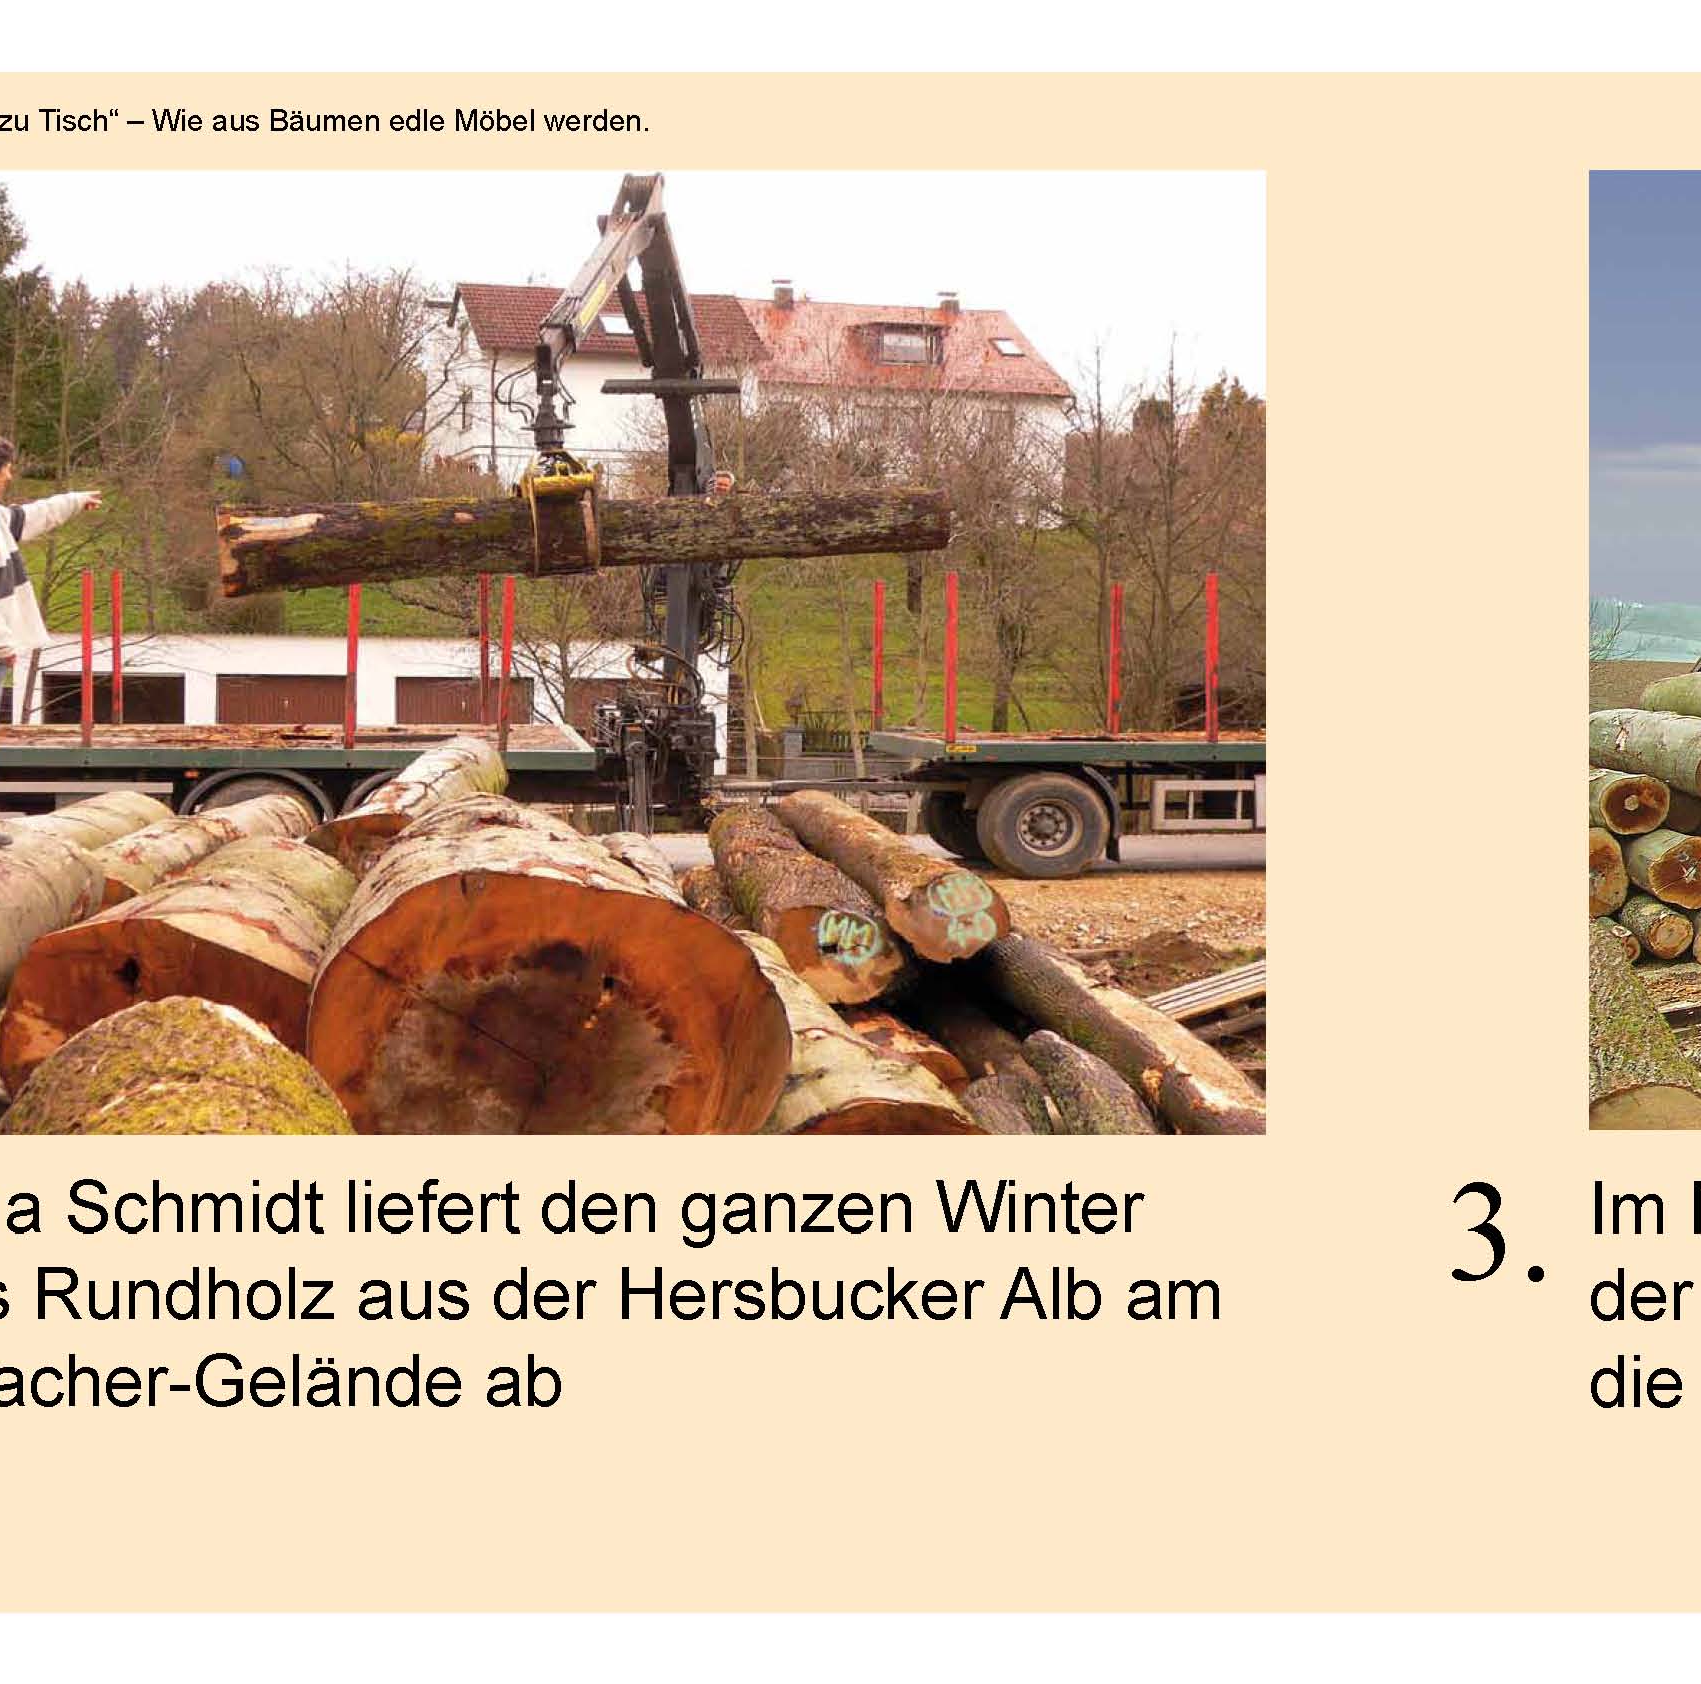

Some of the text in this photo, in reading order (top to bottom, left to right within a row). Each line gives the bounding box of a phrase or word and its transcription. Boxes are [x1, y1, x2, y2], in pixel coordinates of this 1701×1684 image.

[152, 109, 202, 131] Wie
[213, 115, 259, 131] aus
[271, 109, 379, 131] Bäumen
[390, 109, 444, 131] edle
[456, 109, 534, 131] Möbel
[544, 109, 648, 131] werden.
[68, 1179, 324, 1234] Schmidt
[349, 1179, 520, 1234] liefert
[542, 1180, 655, 1234] den
[682, 1193, 911, 1248] ganzen
[936, 1180, 1145, 1234] Winter
[1452, 1182, 1544, 1282] 3.
[1595, 1181, 1663, 1234] Im
[38, 1267, 334, 1320] Rundholz
[359, 1280, 469, 1320] aus
[494, 1267, 597, 1320] der
[622, 1267, 985, 1320] Hersbucker
[1000, 1267, 1101, 1320] Alb
[1128, 1280, 1219, 1320] am
[1591, 1268, 1694, 1321] der
[487, 1354, 561, 1407] ab
[1591, 1355, 1682, 1408] die
